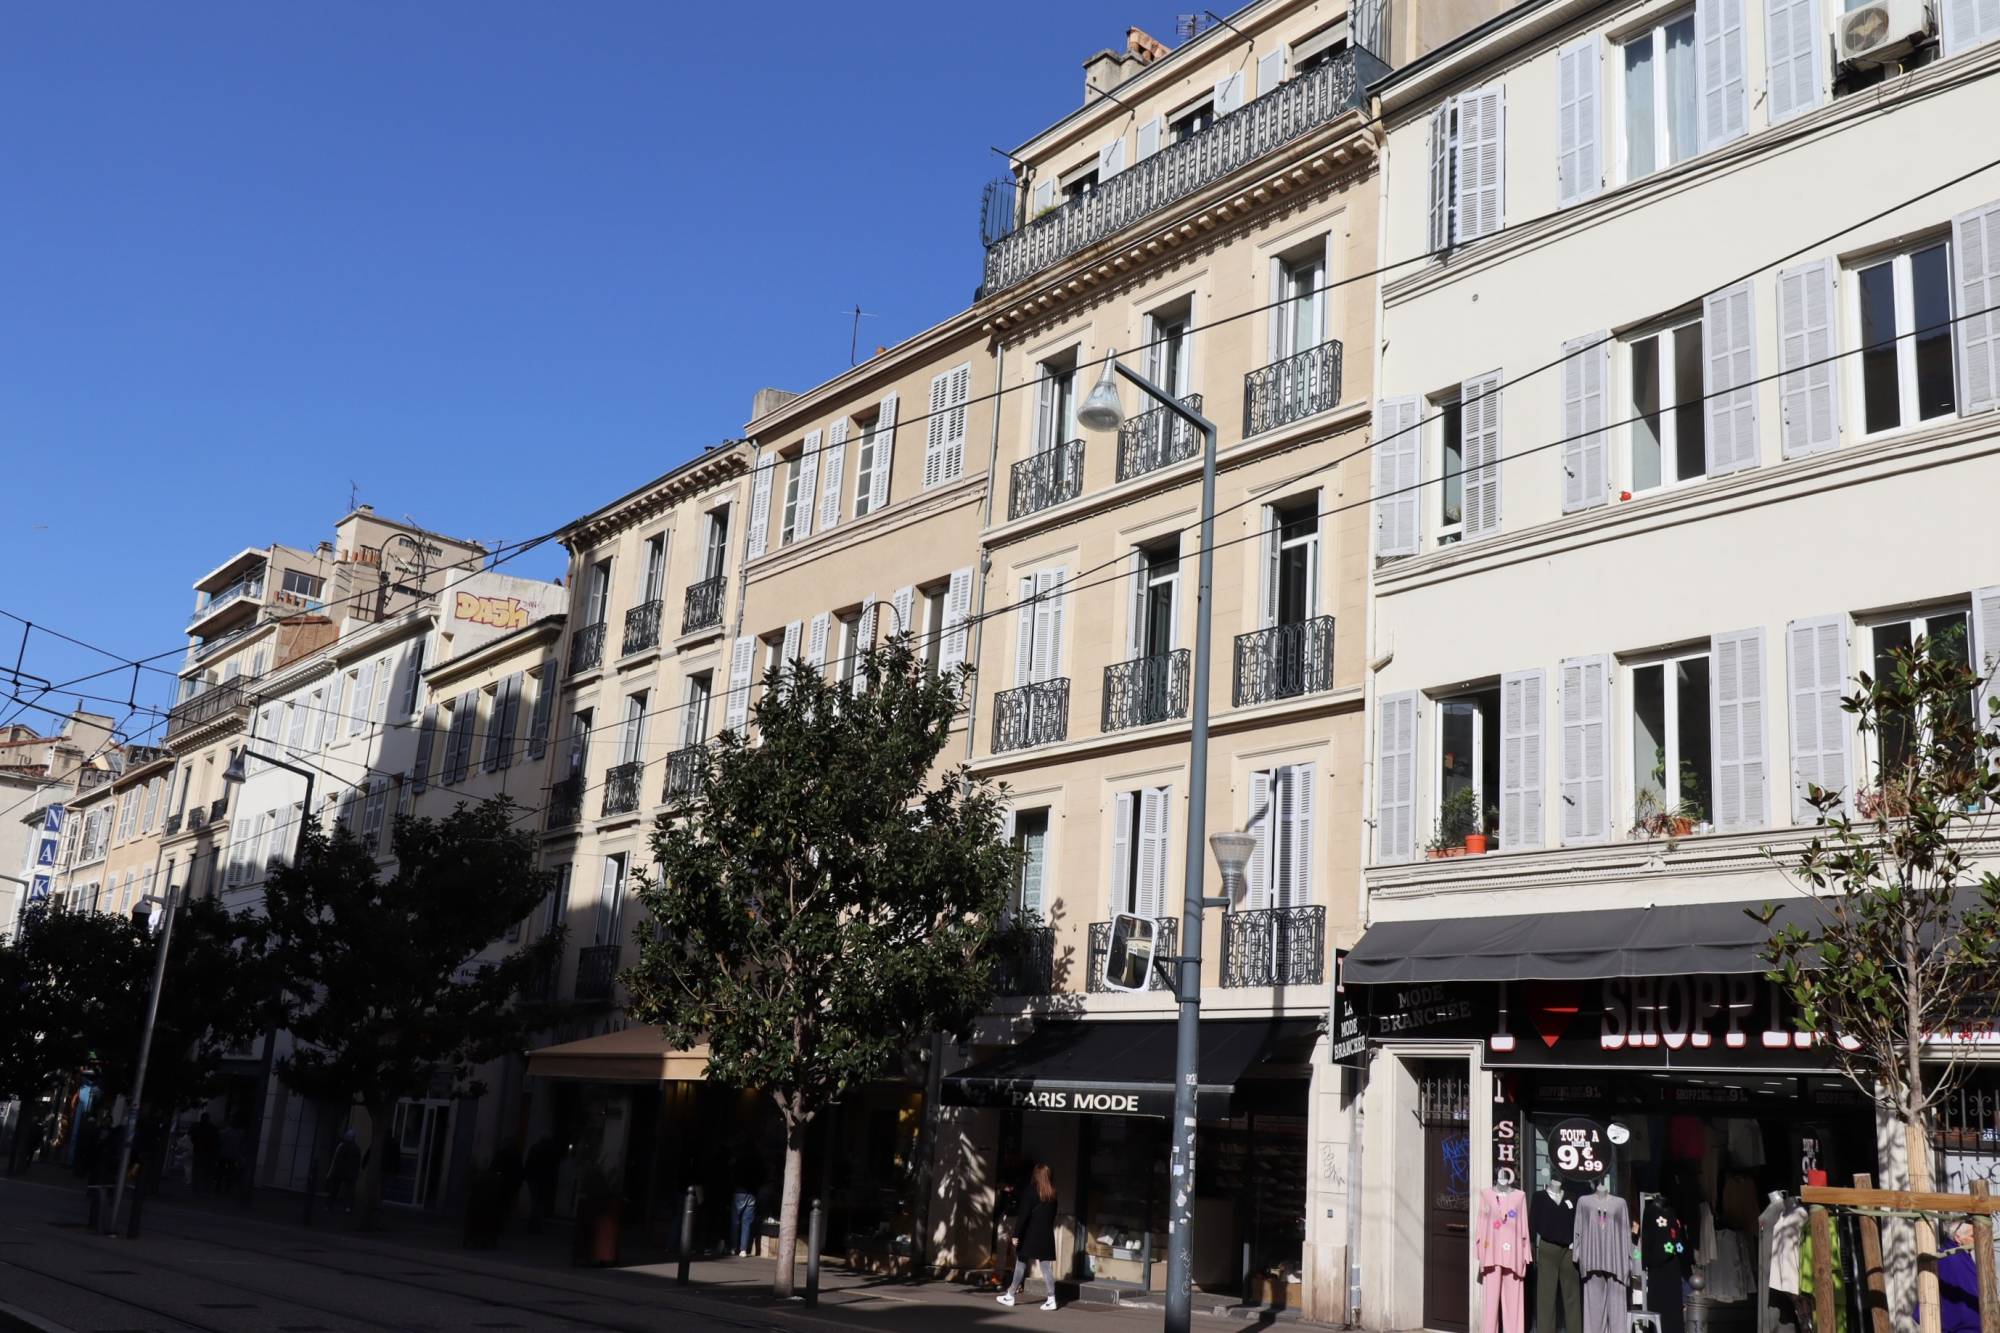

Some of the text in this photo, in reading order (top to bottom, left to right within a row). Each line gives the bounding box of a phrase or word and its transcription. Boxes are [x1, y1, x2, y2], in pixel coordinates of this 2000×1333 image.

[1397, 984, 1445, 1009] MODE
[1344, 1001, 1354, 1017] LA
[1379, 998, 1472, 1033] BRANCHÉE
[1340, 1018, 1358, 1038] MODE
[1333, 1031, 1366, 1061] BRANCHÉE
[1011, 1090, 1140, 1112] PARIS MODE
[1560, 1128, 1587, 1142] TOUT
